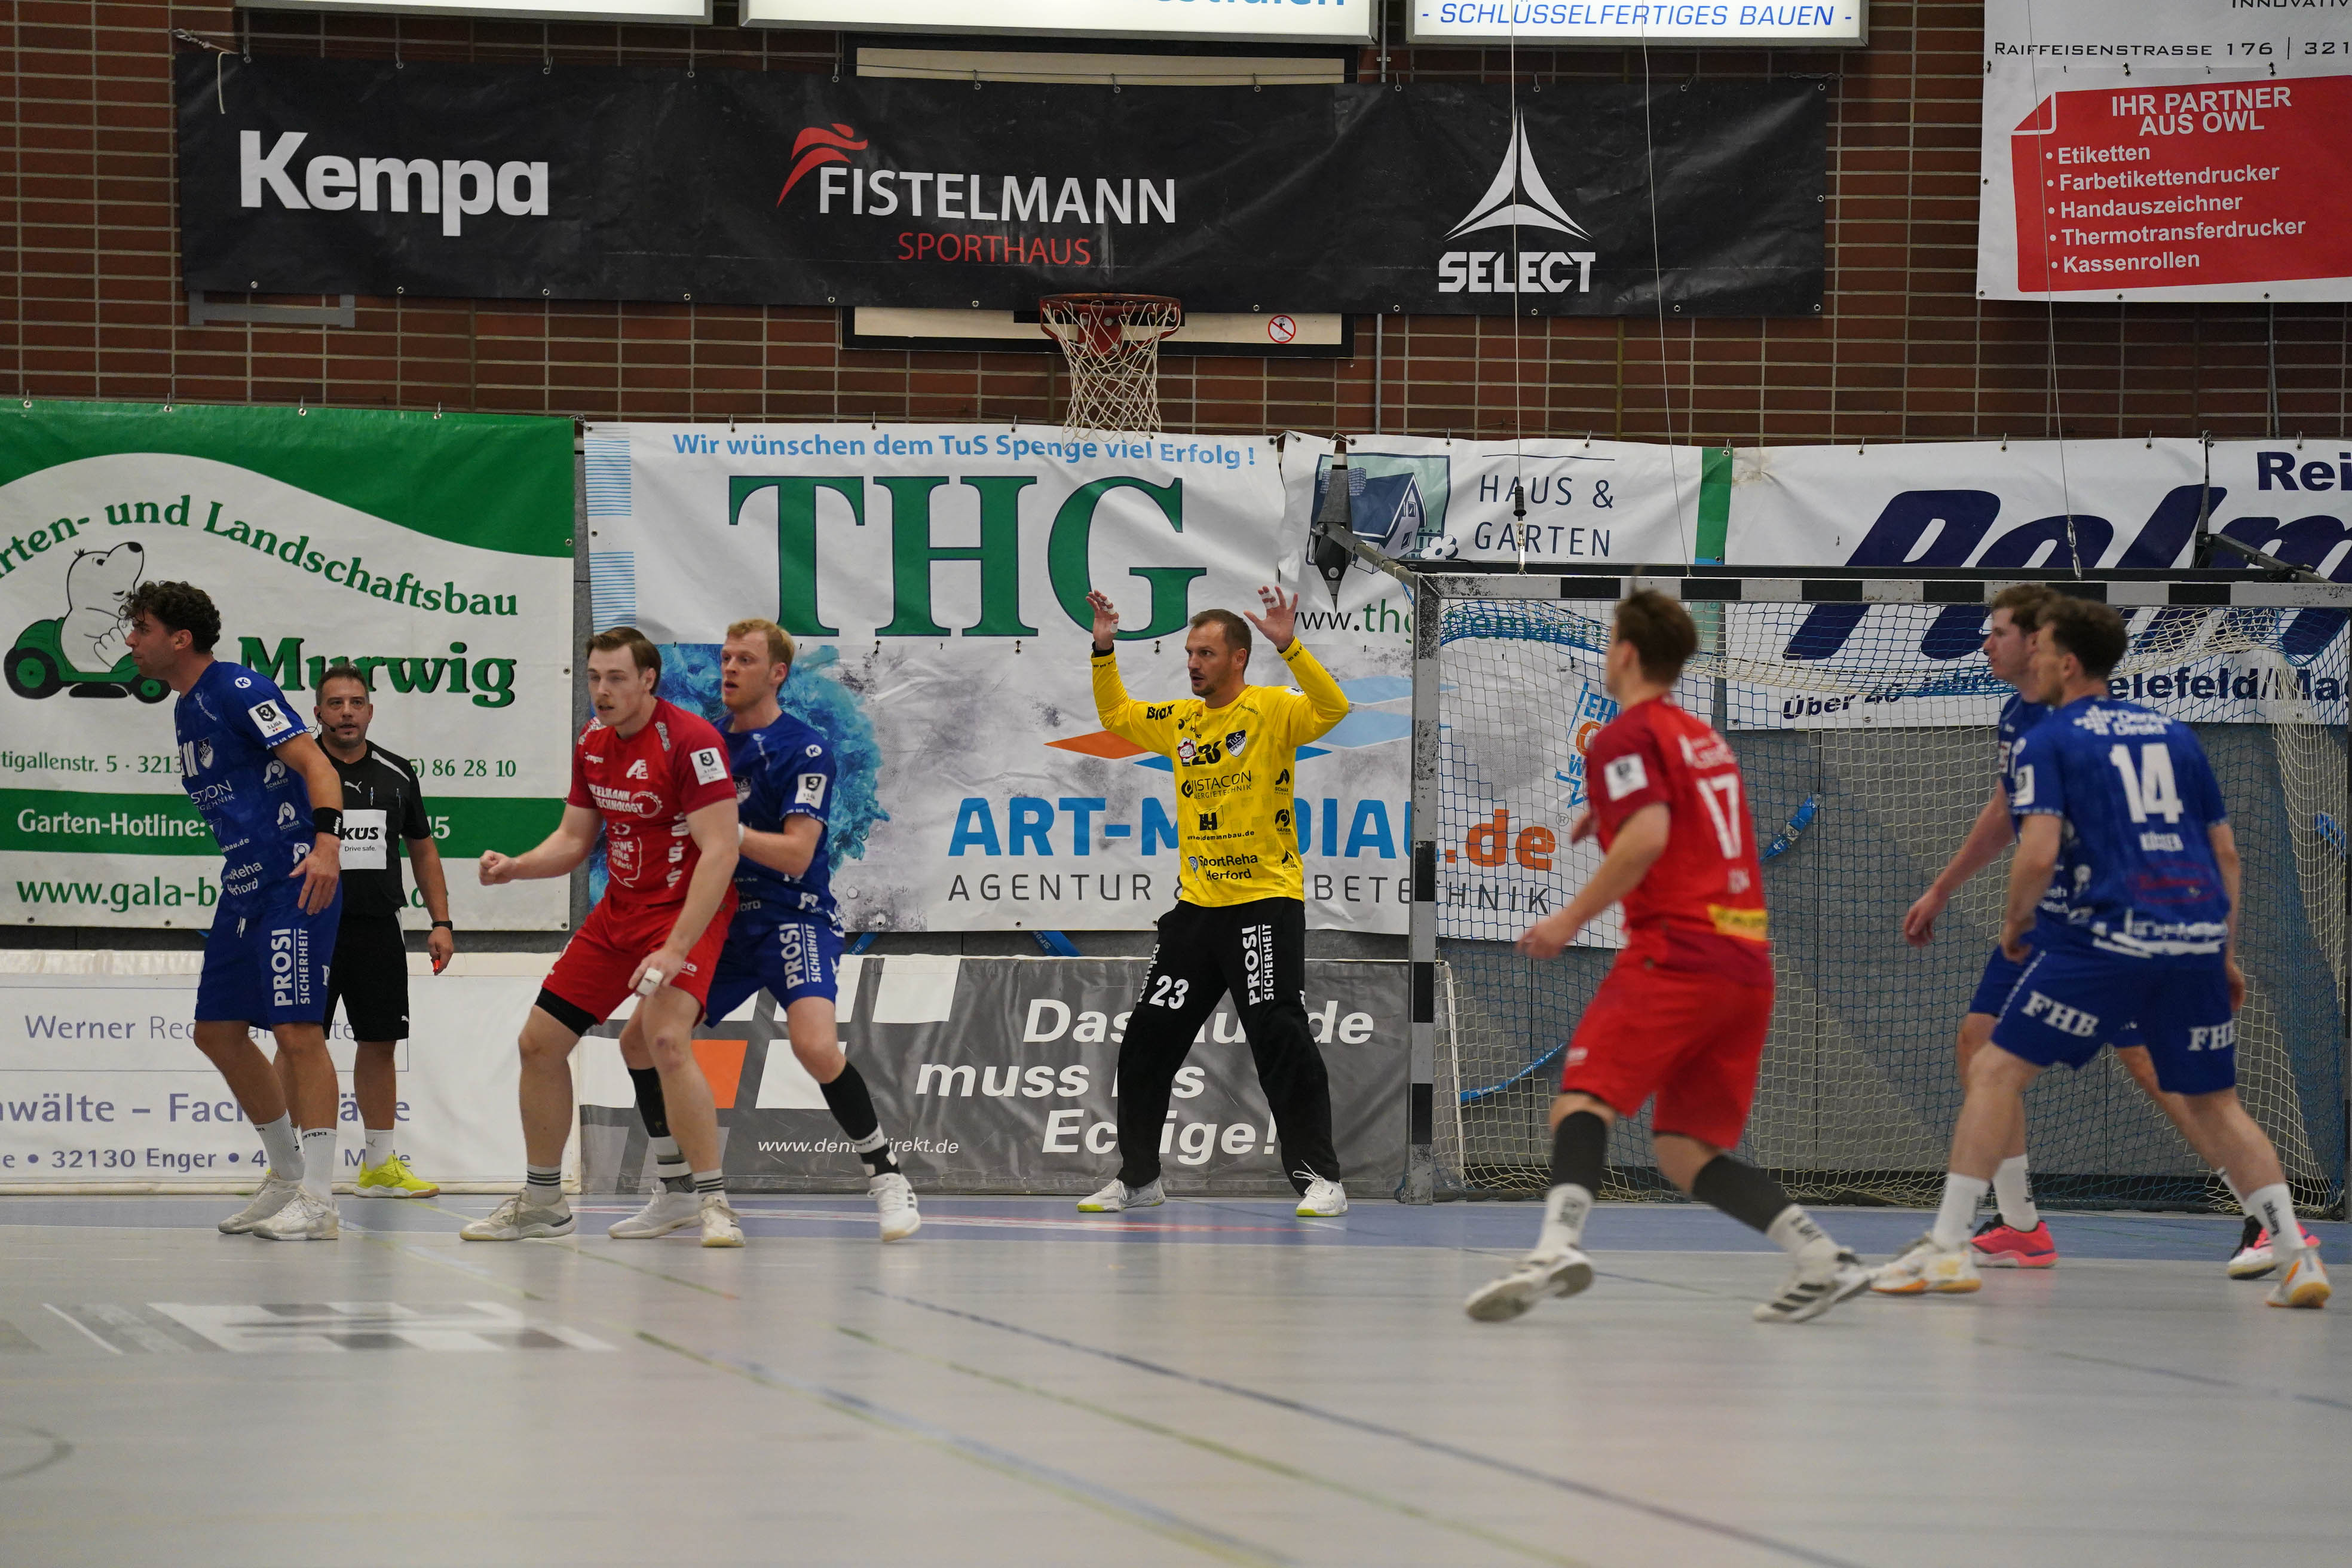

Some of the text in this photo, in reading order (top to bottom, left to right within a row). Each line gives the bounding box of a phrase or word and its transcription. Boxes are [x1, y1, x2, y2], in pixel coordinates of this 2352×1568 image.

[1441, 1, 1728, 26] SCHLÜSSELFERTIGES
[1740, 4, 1834, 26] BAUEN
[1995, 42, 2350, 56] RAIFFEISENSTRASSE 176 321
[2112, 87, 2292, 117] IHR PARTNER
[2139, 111, 2265, 137] AUS OWL
[2057, 144, 2151, 166] Etiketten
[240, 130, 549, 237] Kempa
[2059, 164, 2280, 191] Farbetikettendrucker
[819, 166, 1176, 224] FISTELMANN
[2060, 195, 2243, 219] Handauszeichner
[898, 232, 1091, 266] SPORTHAUS
[2062, 219, 2306, 246] Thermotransferdrucker
[1438, 252, 1596, 293] SELECT
[2063, 251, 2200, 274] Kassenrollen
[673, 433, 719, 456] Wir
[729, 433, 865, 457] wünschen
[873, 434, 932, 457] dem
[939, 434, 988, 457] TuS
[996, 438, 1097, 464] Spenge
[1104, 439, 1152, 460] viel
[1160, 443, 1240, 470] Erfolg
[2257, 451, 2352, 491] Rei
[1480, 475, 1614, 510] HAUS &
[105, 495, 191, 526] und
[203, 501, 518, 617] Landschaftsbau
[1474, 521, 1611, 558] GARTEN
[729, 476, 1206, 641] THG
[1783, 694, 1855, 719] Über
[1228, 733, 1242, 746] TuS
[1229, 738, 1247, 753] SPENGE
[0, 751, 99, 773] tigallenstr.
[106, 755, 117, 773] 5
[137, 755, 182, 773] 3213
[432, 760, 455, 777] 86
[463, 760, 488, 777] 28
[495, 760, 516, 777] 10
[2109, 742, 2183, 823] 14
[17, 808, 206, 837] Garten-Hotline:
[1696, 772, 1742, 859] 17
[341, 826, 379, 841] KÜS
[1199, 853, 1258, 866] SportReha
[1206, 868, 1252, 881] Herford
[948, 874, 1152, 902] AGENTUR
[271, 929, 293, 1006] PROSI
[298, 928, 310, 1004] SICHERHEIT
[779, 923, 804, 990] PROSI
[806, 924, 822, 984] SICHERHEIT
[1242, 926, 1262, 1006] PROSI
[1262, 923, 1275, 1001] SICHERHEIT
[1149, 975, 1189, 1010] 23
[25, 1015, 136, 1039] Werner
[2021, 990, 2100, 1037] FHB
[917, 1063, 1091, 1099] muss
[1042, 1109, 1277, 1165] Ecige!
[51, 1149, 136, 1169] 32130
[147, 1147, 216, 1172] Enger
